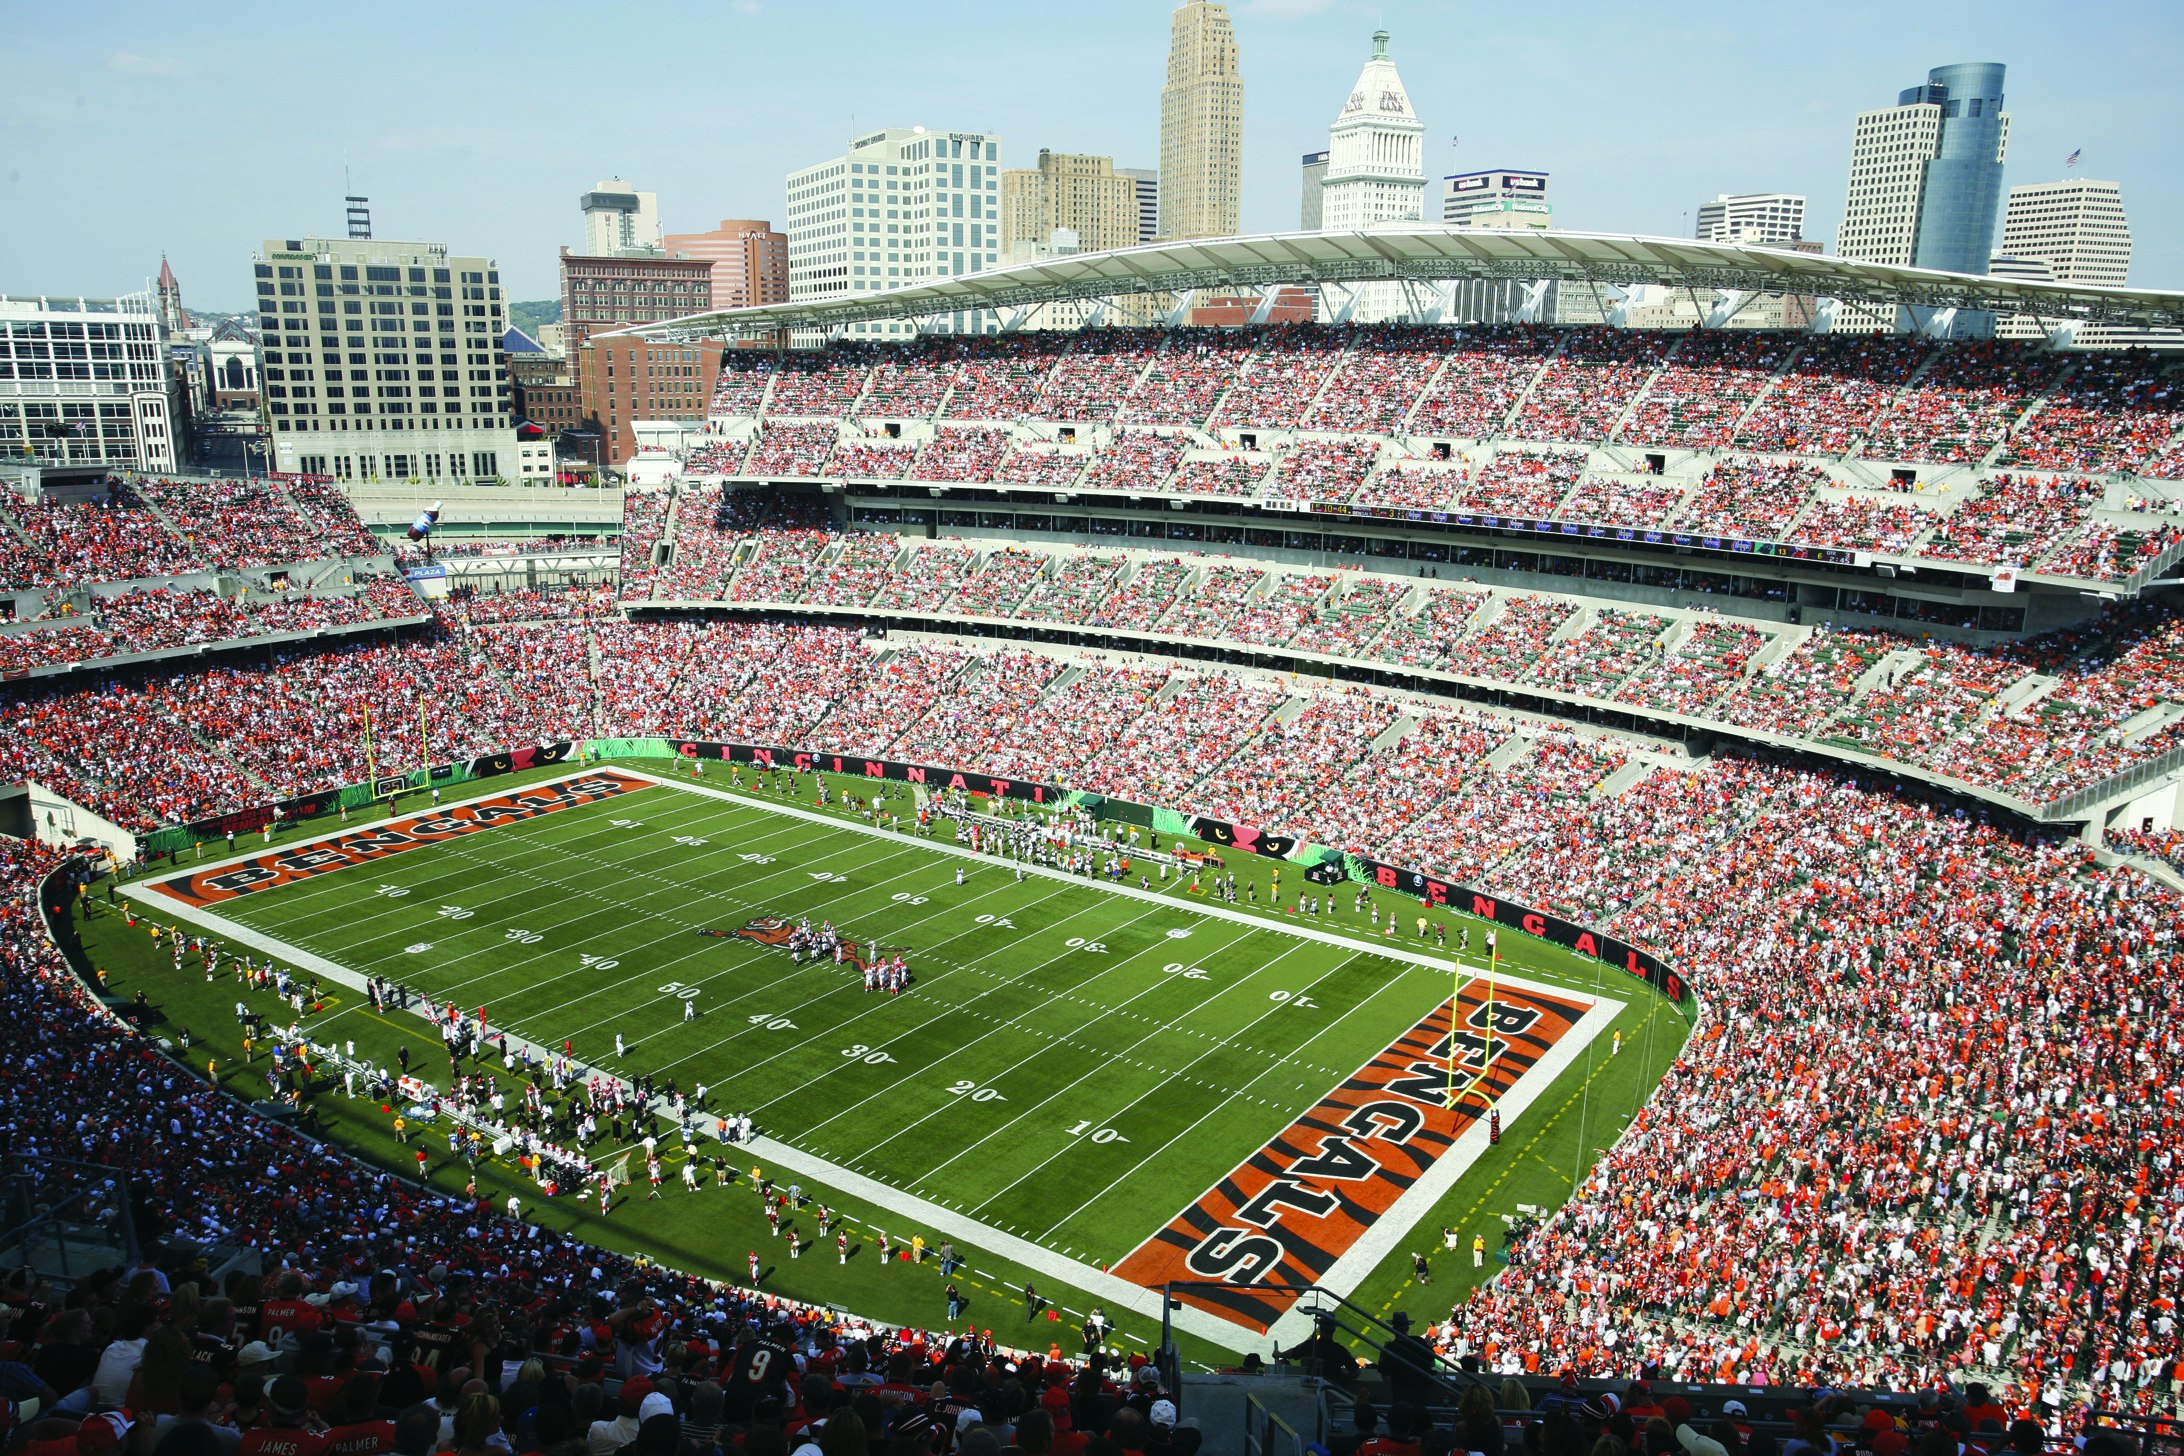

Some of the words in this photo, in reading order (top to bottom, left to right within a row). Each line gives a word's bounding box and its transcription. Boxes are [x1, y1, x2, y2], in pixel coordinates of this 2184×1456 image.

[949, 133, 985, 142] ENQUIRER
[738, 231, 767, 240] HYATT
[414, 568, 441, 577] PLAZA
[680, 743, 1043, 802] CINCINNATI
[382, 781, 400, 793] 25
[200, 778, 622, 892] BENGALS
[377, 884, 411, 898] 10
[891, 892, 930, 906] 50
[438, 905, 475, 920] 20
[506, 928, 544, 944] 30
[1375, 866, 1681, 998] BENGALS
[581, 953, 619, 970] 40
[1163, 963, 1208, 979] 20
[657, 981, 701, 999] 50
[1269, 990, 1314, 1007] 10
[747, 1014, 789, 1031] 40
[841, 1044, 890, 1065] 30
[946, 1080, 998, 1102] 20
[1065, 1120, 1119, 1144] 10
[1184, 1001, 1544, 1291] BENGALS
[267, 1308, 295, 1317] PALMER
[758, 1339, 787, 1353] PALMER
[748, 1349, 772, 1383] 9
[257, 1440, 298, 1456] JAMES
[336, 1436, 379, 1453] PALMER
